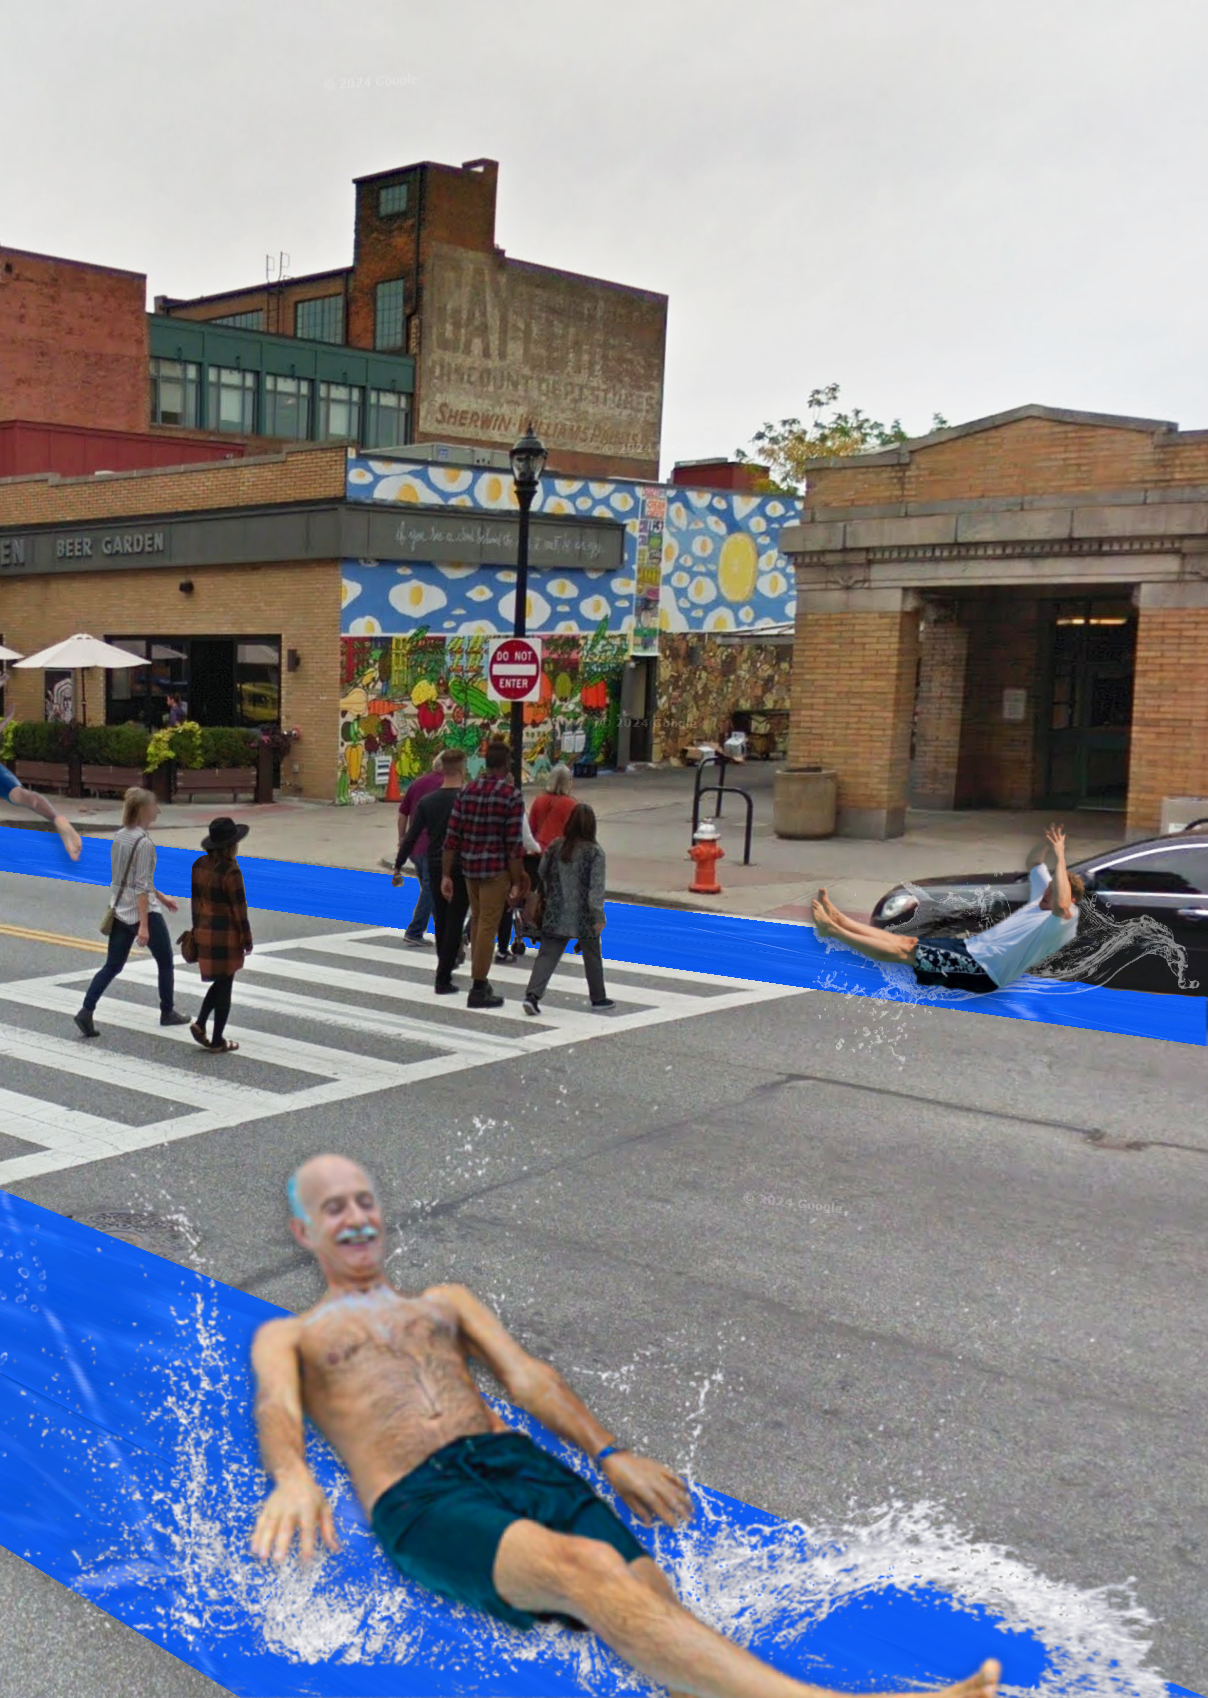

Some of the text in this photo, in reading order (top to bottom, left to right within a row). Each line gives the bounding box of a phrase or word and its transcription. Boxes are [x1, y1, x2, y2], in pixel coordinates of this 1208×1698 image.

[56, 532, 164, 558] BEER GARDEN
[496, 651, 533, 662] DO NOT
[499, 678, 529, 689] ENTER
